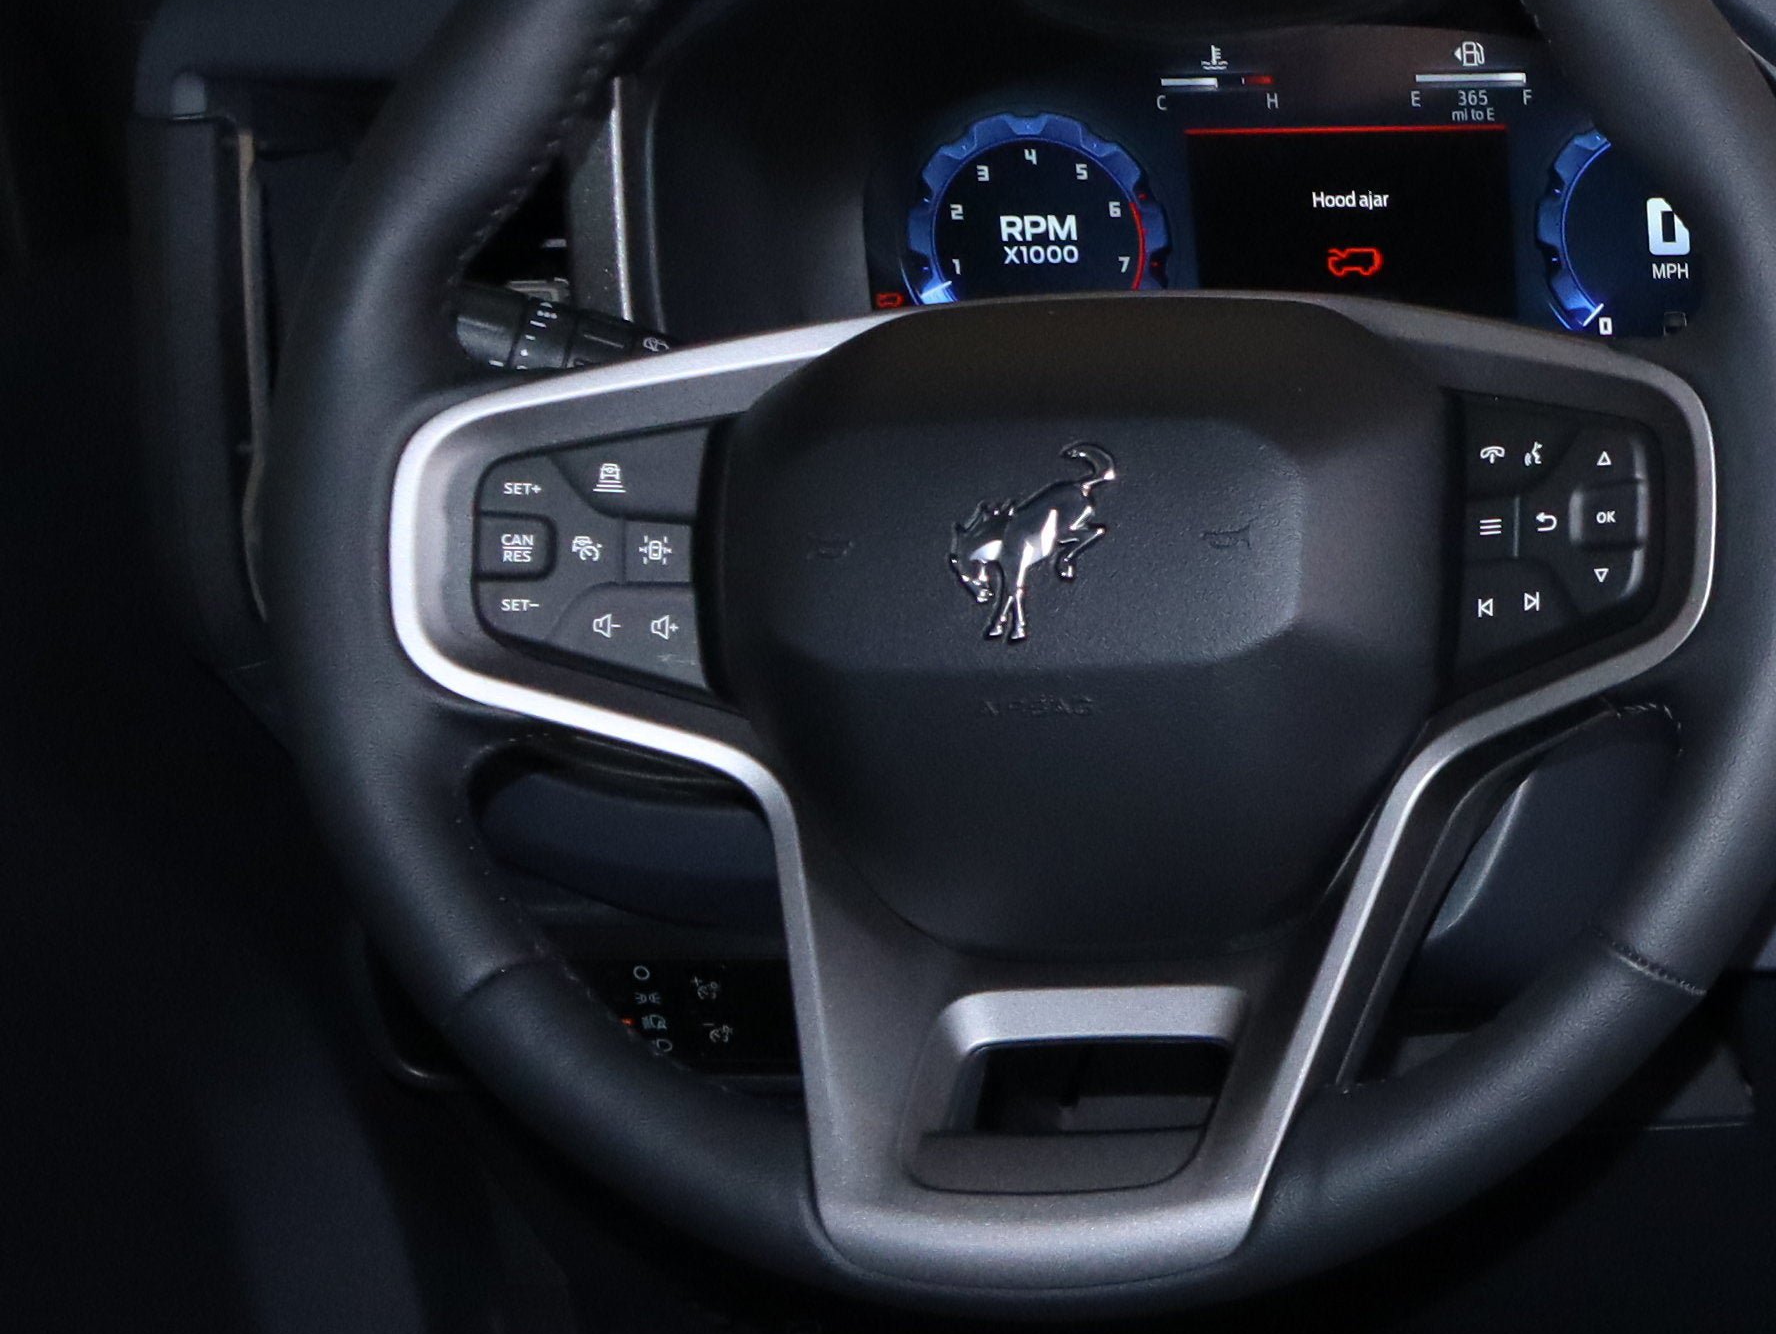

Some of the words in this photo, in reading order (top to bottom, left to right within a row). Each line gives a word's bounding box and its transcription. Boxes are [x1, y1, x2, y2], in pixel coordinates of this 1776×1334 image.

[1155, 94, 1168, 111] C
[1266, 92, 1279, 110] H
[1411, 91, 1421, 107] E
[1457, 89, 1489, 107] 365
[1522, 89, 1532, 106] F
[1451, 108, 1466, 122] mi
[1468, 108, 1483, 122] to
[1486, 107, 1495, 121] E
[1023, 148, 1038, 166] 4
[976, 165, 990, 182] 3
[1075, 163, 1089, 181] 5
[1108, 201, 1122, 219] 6
[1311, 191, 1355, 209] Hood
[1358, 191, 1390, 214] ajar
[950, 203, 965, 221] 2
[999, 214, 1078, 242] RPM
[1003, 245, 1079, 265] X1000
[952, 258, 962, 276] 1
[1117, 256, 1130, 274] 7
[1652, 263, 1689, 280] MPH
[503, 482, 542, 496] SET+
[1596, 510, 1616, 524] OK
[501, 533, 534, 546] CAN
[502, 550, 532, 563] RES
[500, 598, 540, 612] SET-
